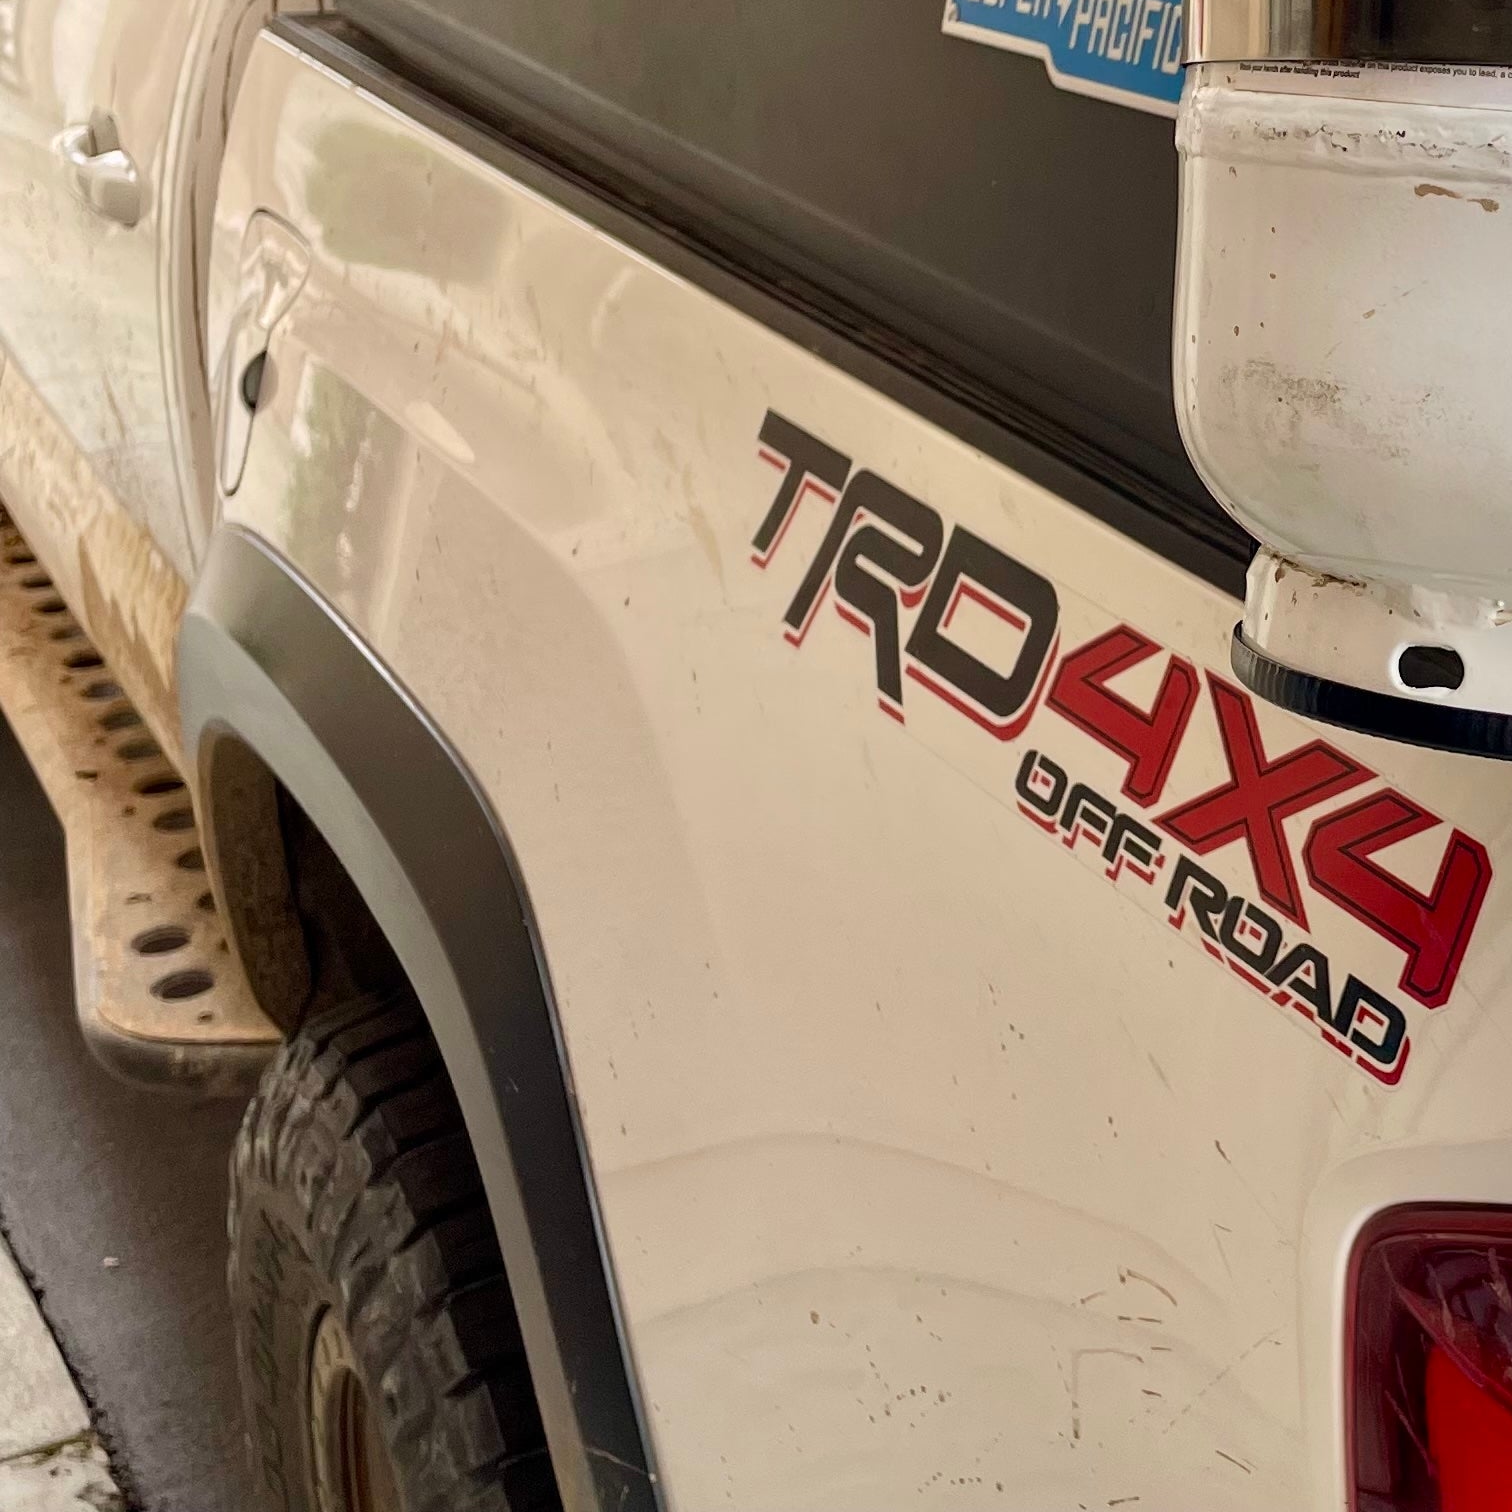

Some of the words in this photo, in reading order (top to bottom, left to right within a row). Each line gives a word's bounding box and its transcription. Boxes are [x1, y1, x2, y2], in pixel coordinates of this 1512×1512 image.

[751, 407, 1060, 742] TRD
[1044, 622, 1494, 1010] 4X4
[1014, 749, 1165, 885] OFF
[1165, 854, 1411, 1085] ROAD
